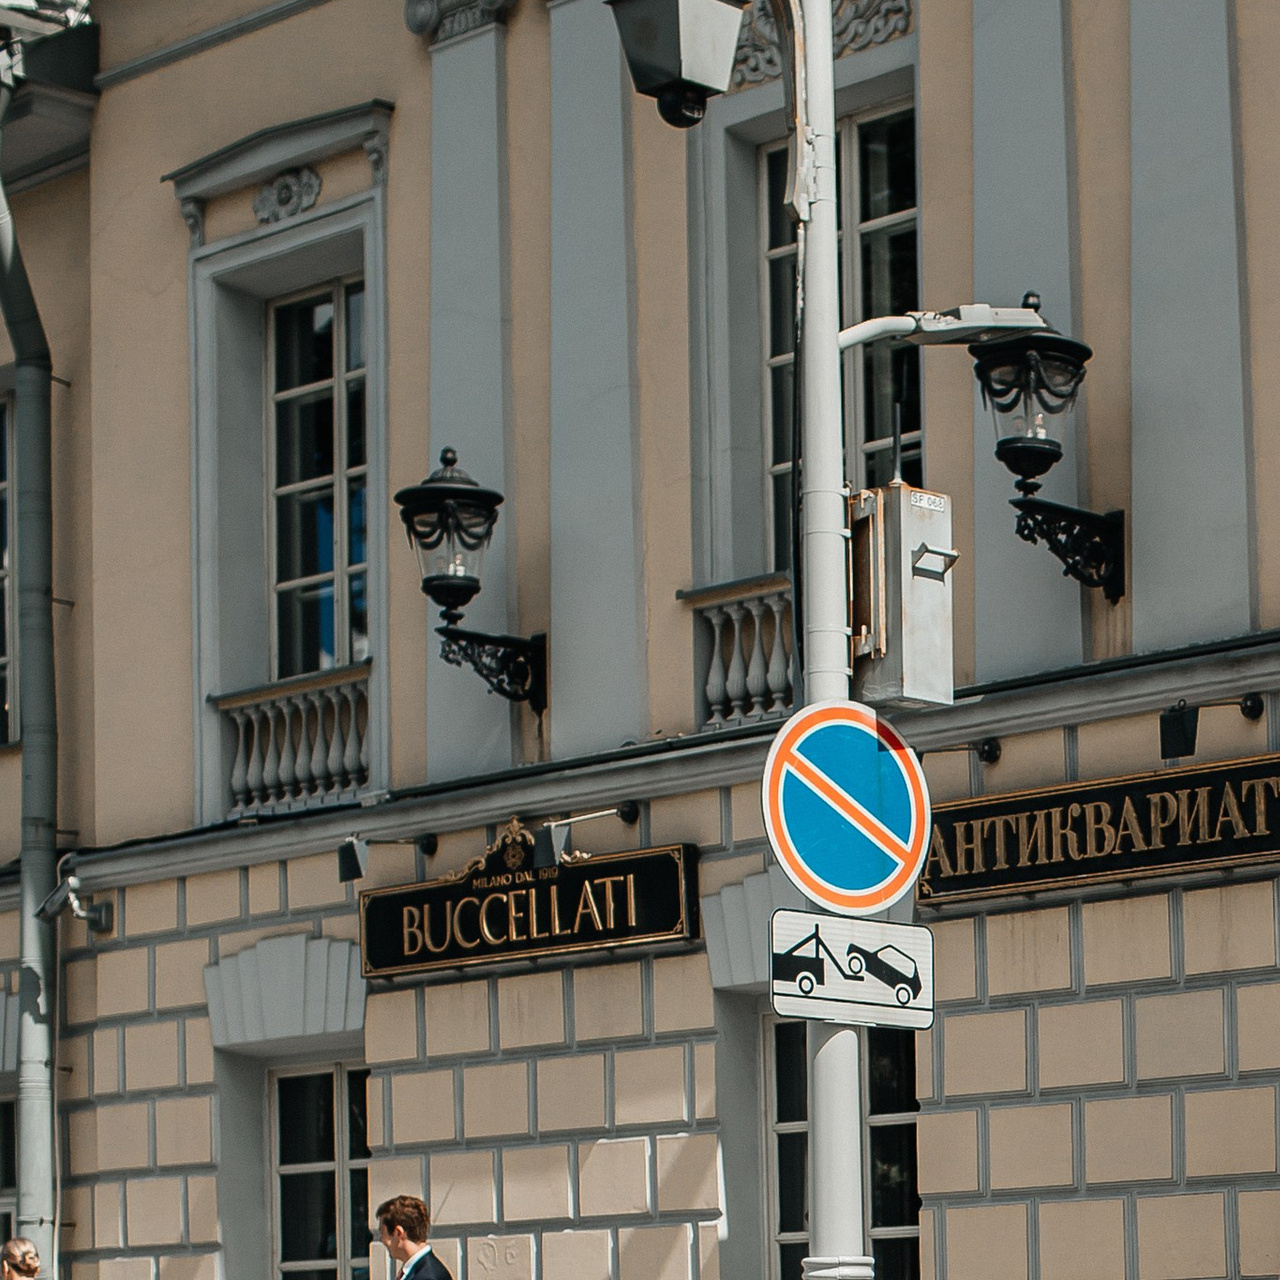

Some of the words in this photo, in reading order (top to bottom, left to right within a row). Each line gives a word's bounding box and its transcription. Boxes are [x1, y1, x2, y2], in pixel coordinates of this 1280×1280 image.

[911, 492, 925, 504] SF
[472, 873, 512, 889] MILANO
[515, 870, 535, 884] DAL
[539, 866, 559, 880] 1919
[403, 874, 635, 956] BUCCELLATI
